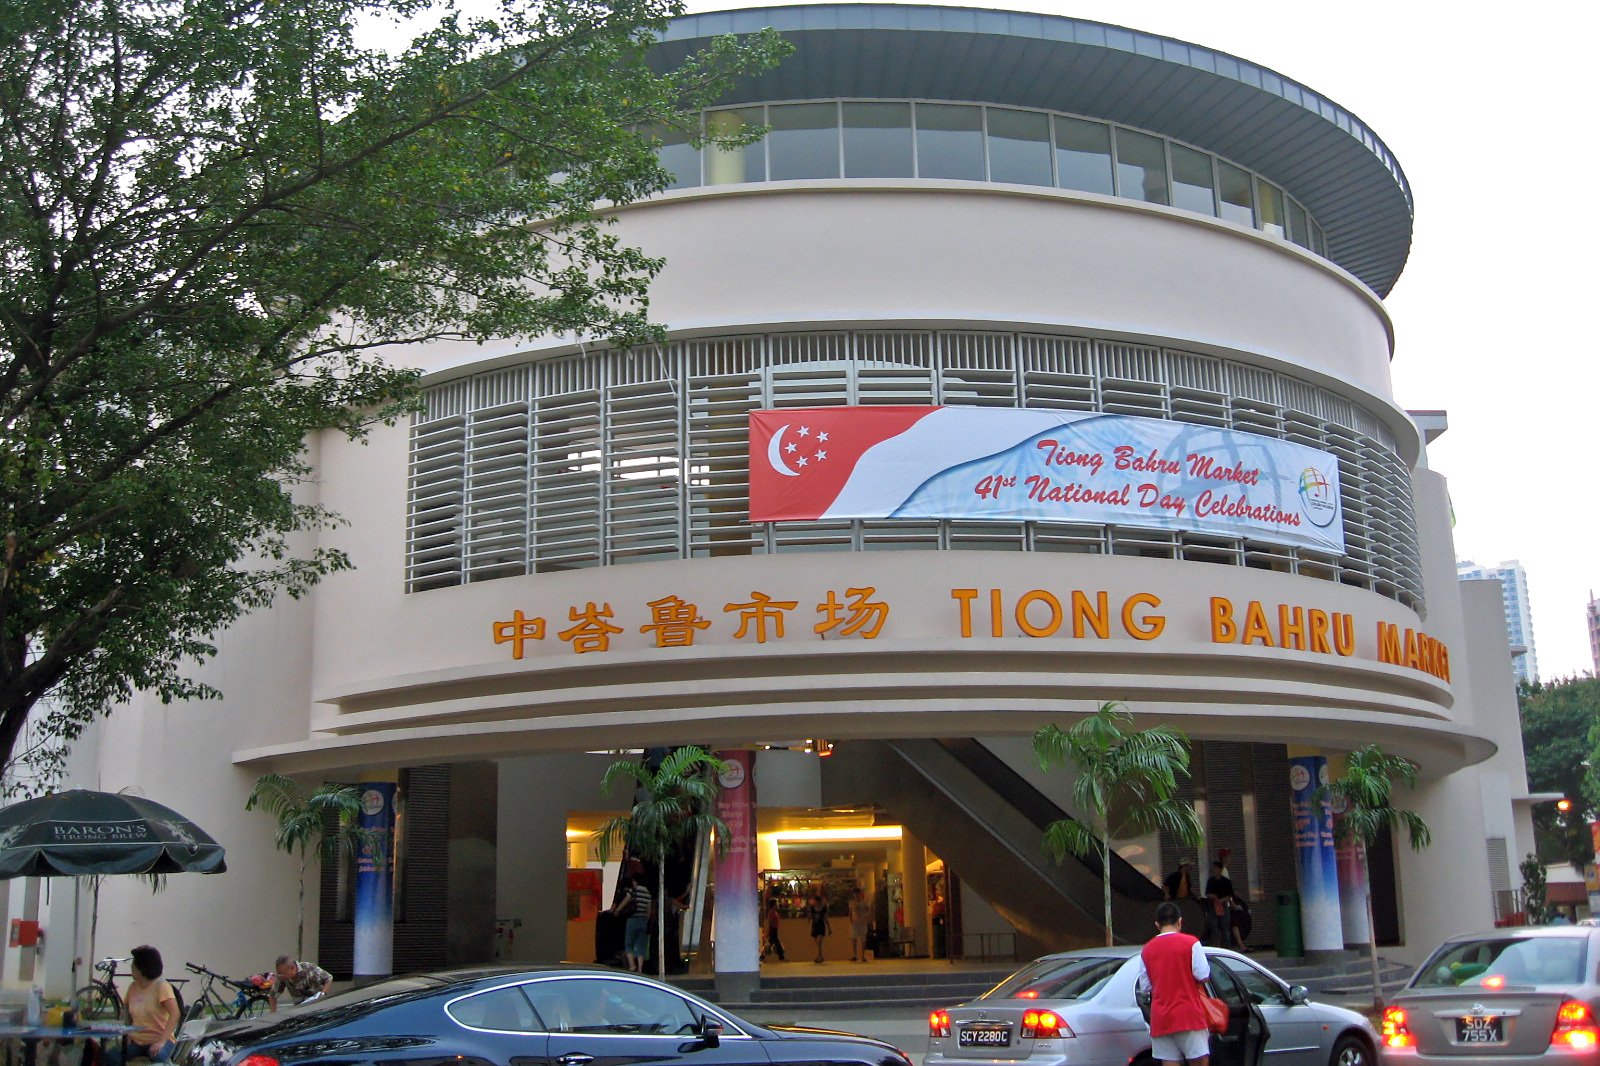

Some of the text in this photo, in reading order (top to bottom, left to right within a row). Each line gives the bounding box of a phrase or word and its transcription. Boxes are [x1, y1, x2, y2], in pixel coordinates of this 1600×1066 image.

[1036, 438, 1260, 486] Tiong Bahru Market
[974, 474, 1302, 528] 41st National Day Celebrations
[950, 587, 1166, 642] TIONG
[1209, 595, 1357, 657] BAHRU
[54, 824, 147, 835] BARON'S
[54, 831, 148, 841] STRONG BREW
[960, 1030, 1008, 1043] SCY2280C
[1461, 1029, 1498, 1043] 755X
